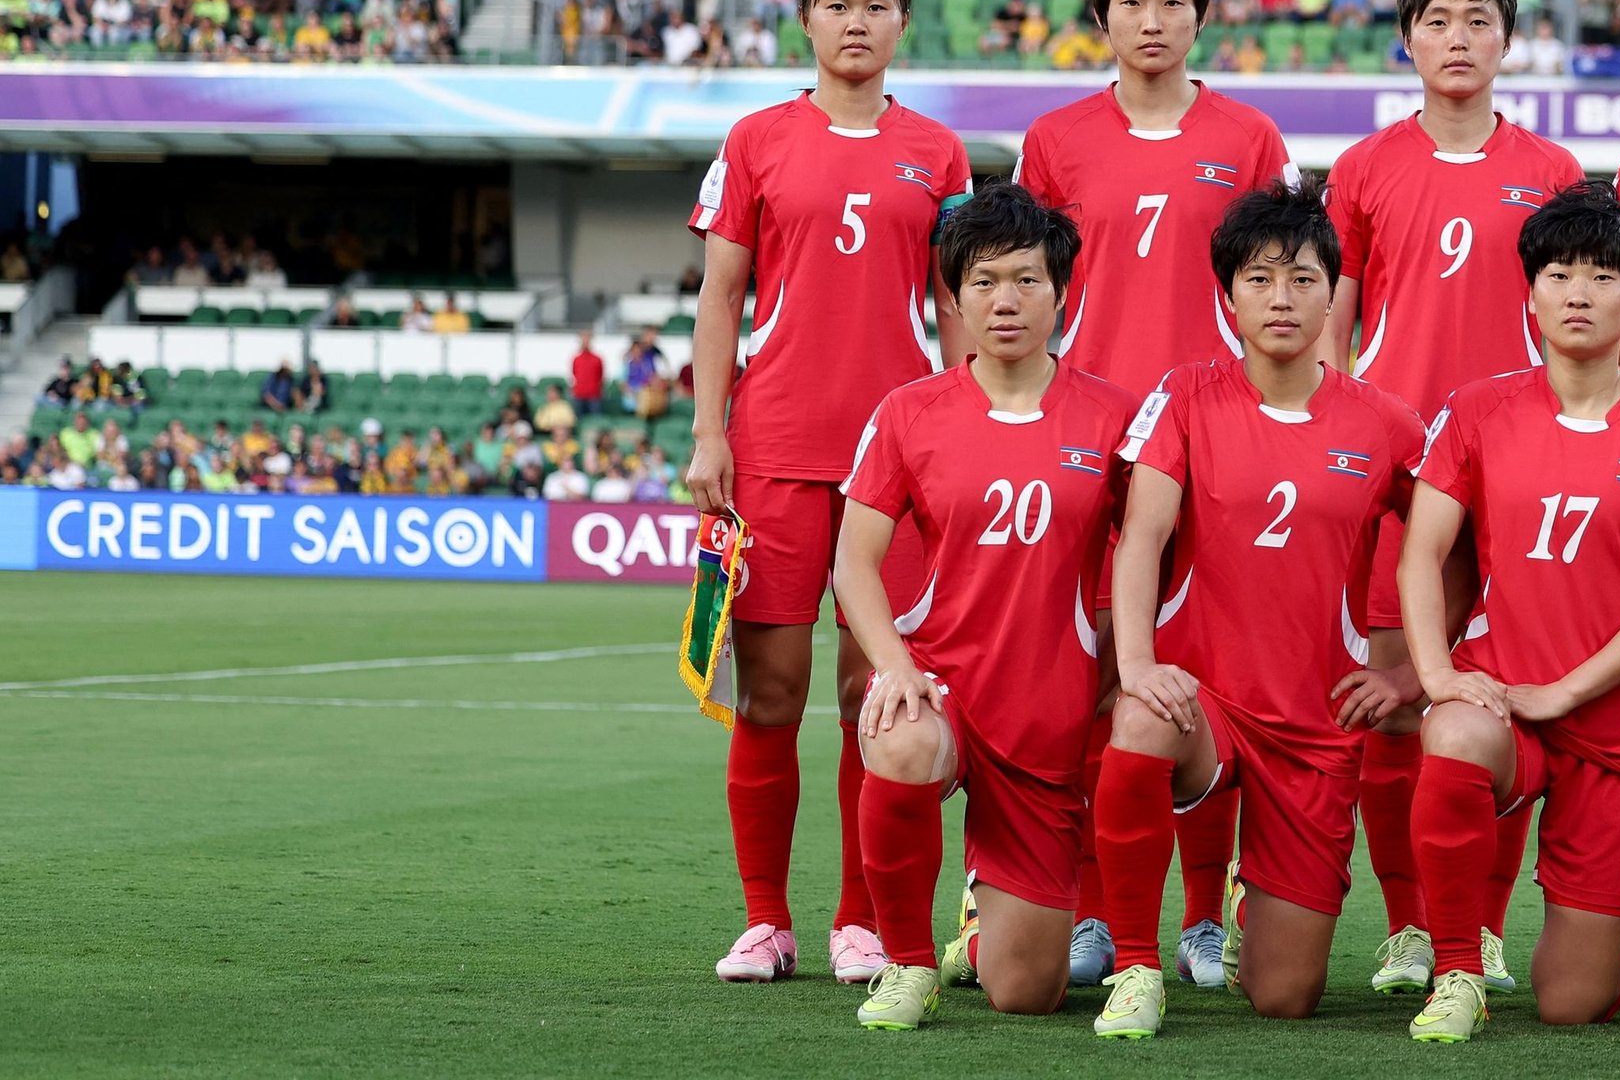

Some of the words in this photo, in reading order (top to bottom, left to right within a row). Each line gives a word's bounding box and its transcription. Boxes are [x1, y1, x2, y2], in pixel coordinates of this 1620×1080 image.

[834, 192, 872, 255] 5
[1135, 194, 1169, 258] 7
[1439, 216, 1473, 279] 9
[47, 499, 275, 561] CREDIT
[291, 505, 535, 567] SAISON
[571, 511, 699, 577] QAT
[977, 478, 1052, 545] 20
[1253, 480, 1298, 548] 2
[1525, 492, 1600, 564] 17
